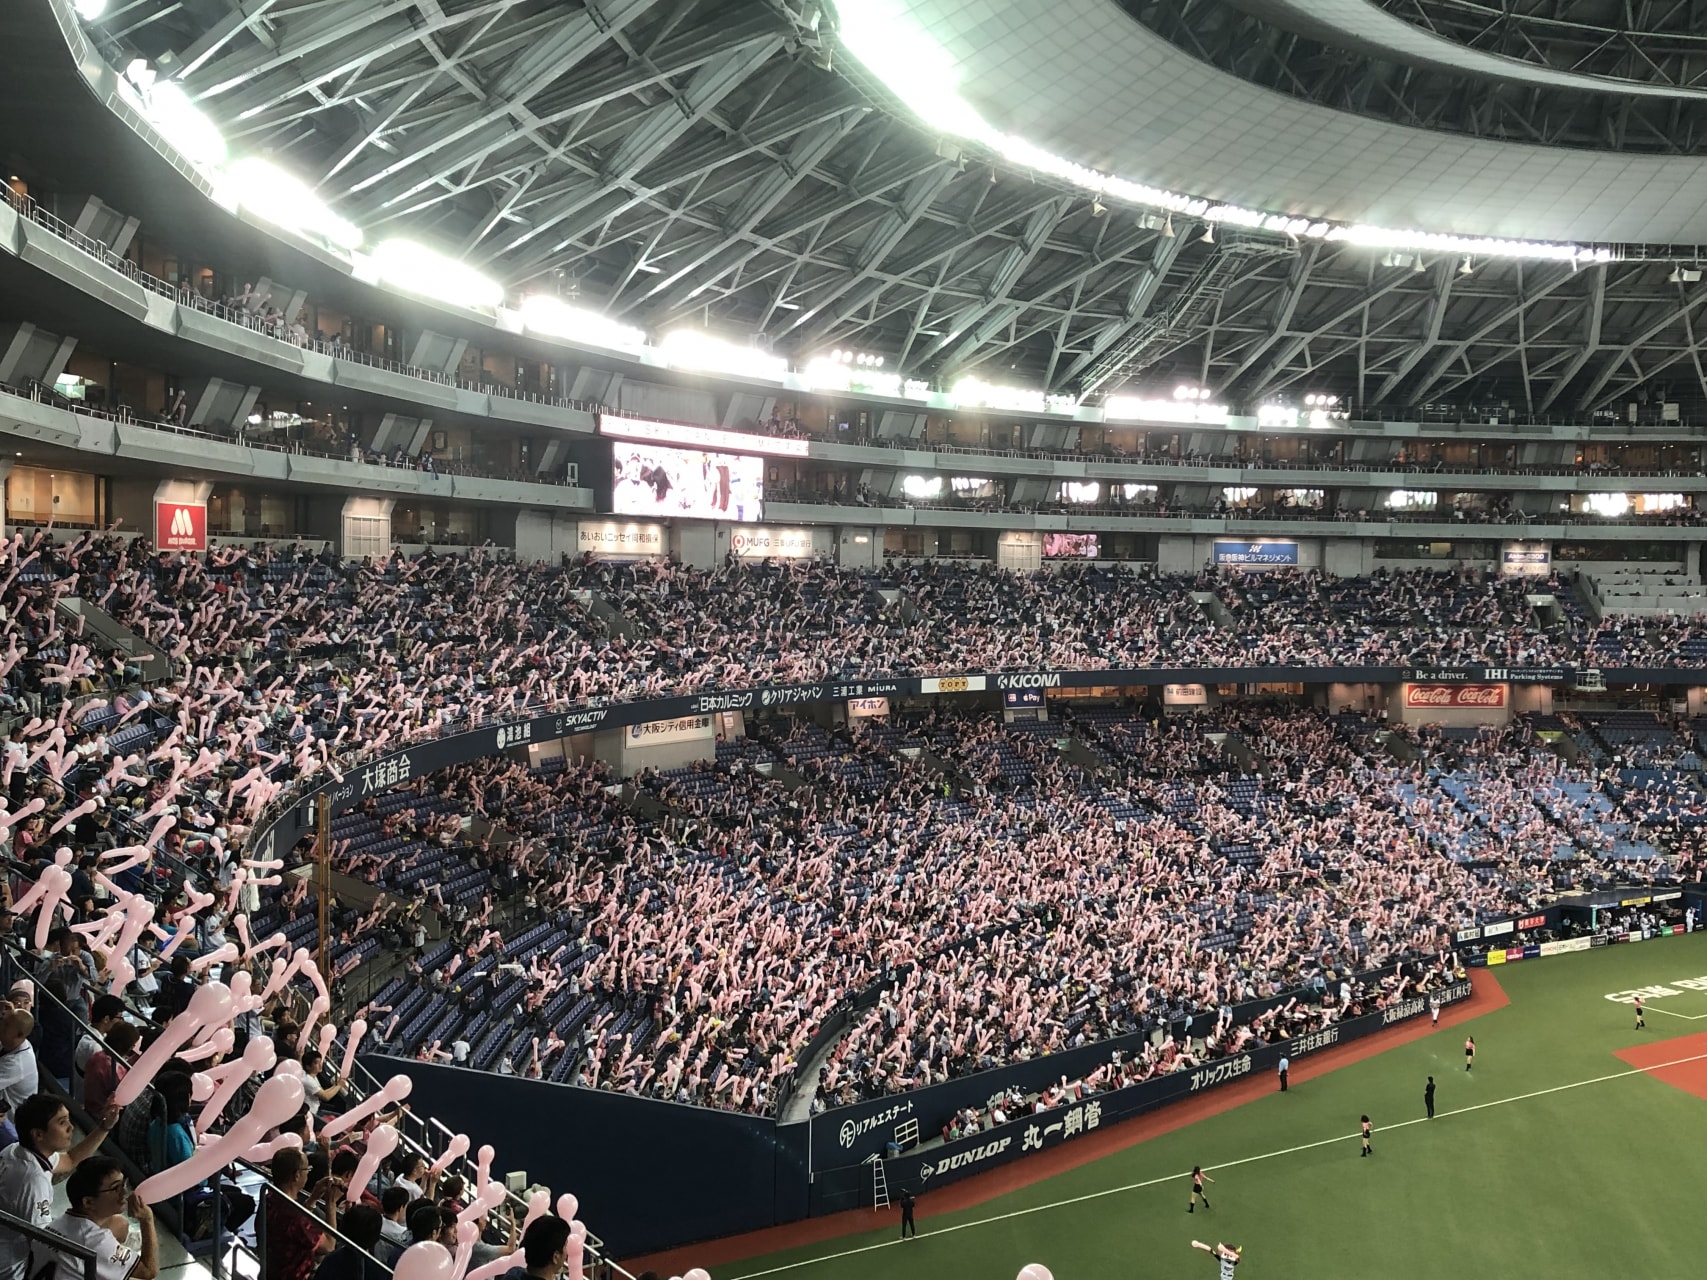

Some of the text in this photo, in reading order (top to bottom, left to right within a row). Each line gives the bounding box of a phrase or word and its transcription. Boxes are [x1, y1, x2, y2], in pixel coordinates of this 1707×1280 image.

[746, 537, 770, 547] MUFG
[1009, 674, 1060, 688] KICONA
[1416, 670, 1429, 679] Be
[1438, 670, 1468, 680] driver.
[1485, 669, 1508, 680] IHI
[1510, 673, 1563, 681] Parking Systems
[770, 687, 823, 704] クリアジャパン
[833, 685, 864, 697] 三浦工業
[701, 693, 753, 712] 日本カルミック
[850, 699, 885, 711] アイホン
[565, 710, 608, 727] SKYACTIV
[643, 717, 710, 735] 大阪シティ信用金庫
[361, 753, 411, 796] 大塚商会
[1290, 1027, 1339, 1057] 三井住友銀行
[1190, 1054, 1252, 1091] オリックス生命
[856, 1099, 914, 1136] リアルエステート
[1022, 1100, 1102, 1152] 丸一鋼管
[935, 1136, 1012, 1175] DUNLOP
